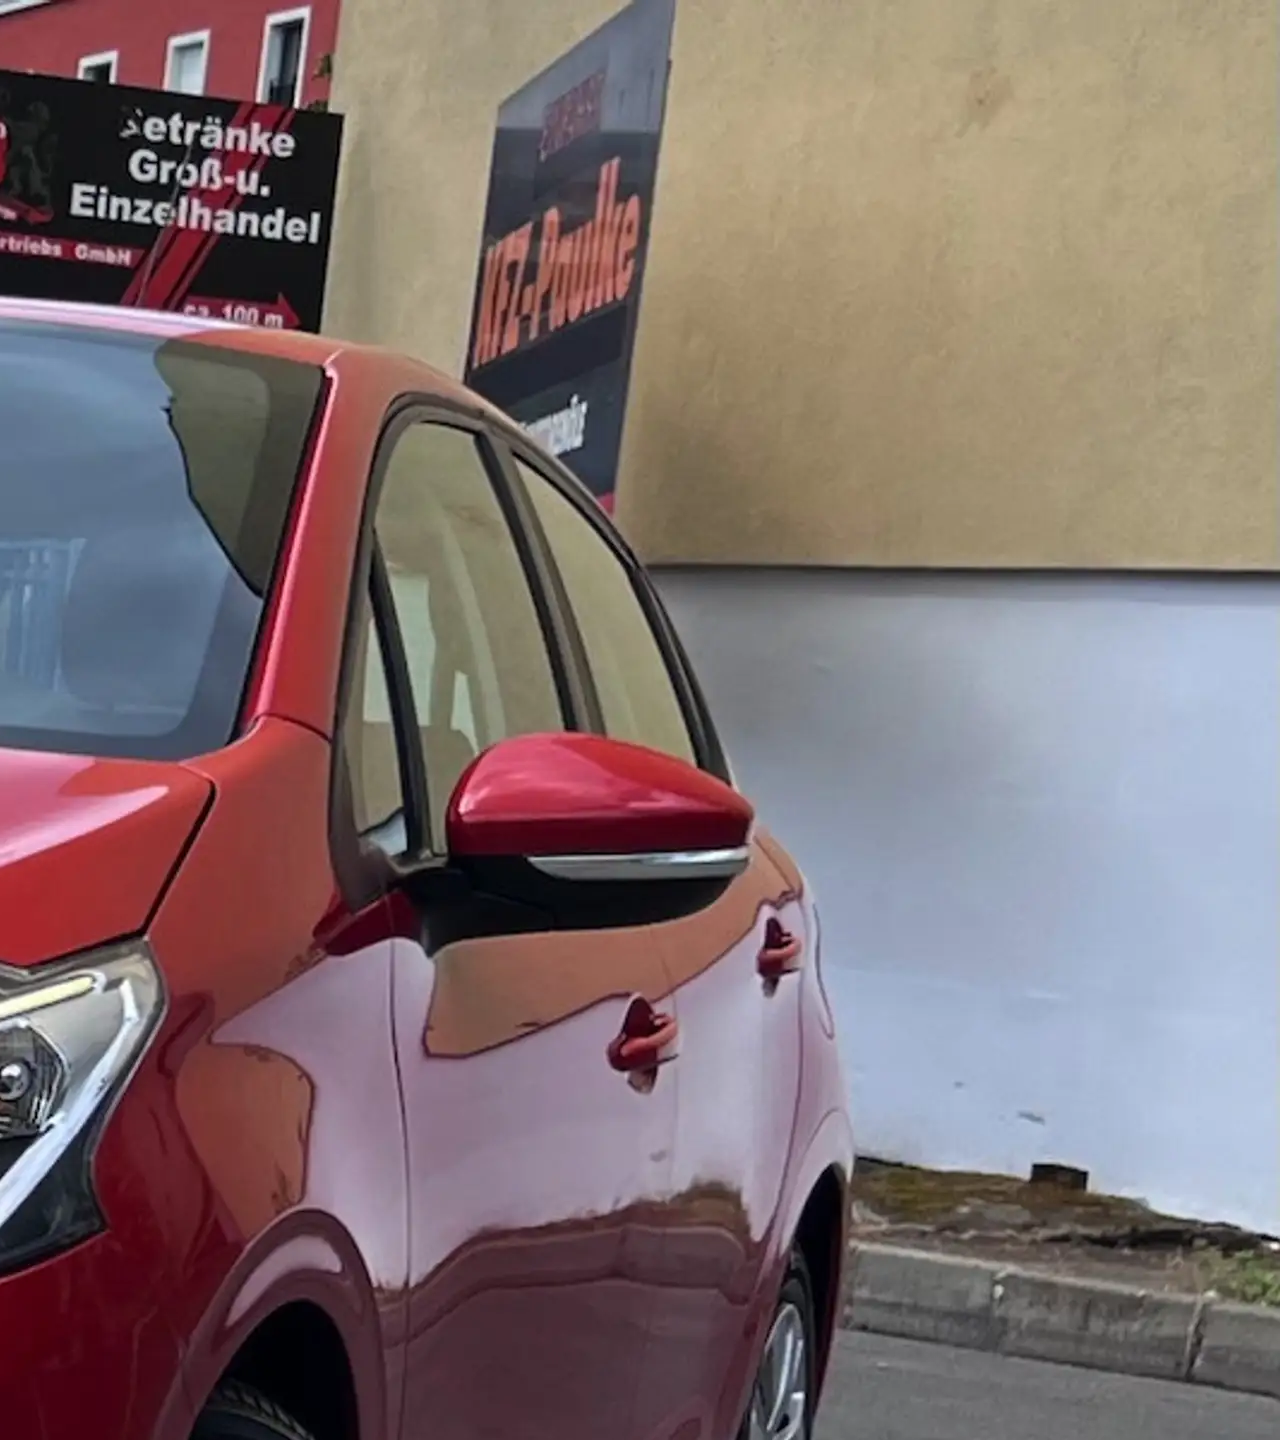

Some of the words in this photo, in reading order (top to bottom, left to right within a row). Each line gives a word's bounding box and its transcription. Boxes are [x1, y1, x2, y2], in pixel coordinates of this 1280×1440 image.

[69, 182, 322, 244] Einzelhandel
[74, 244, 132, 266] GmbH
[221, 303, 259, 326] 100
[264, 313, 283, 329] m
